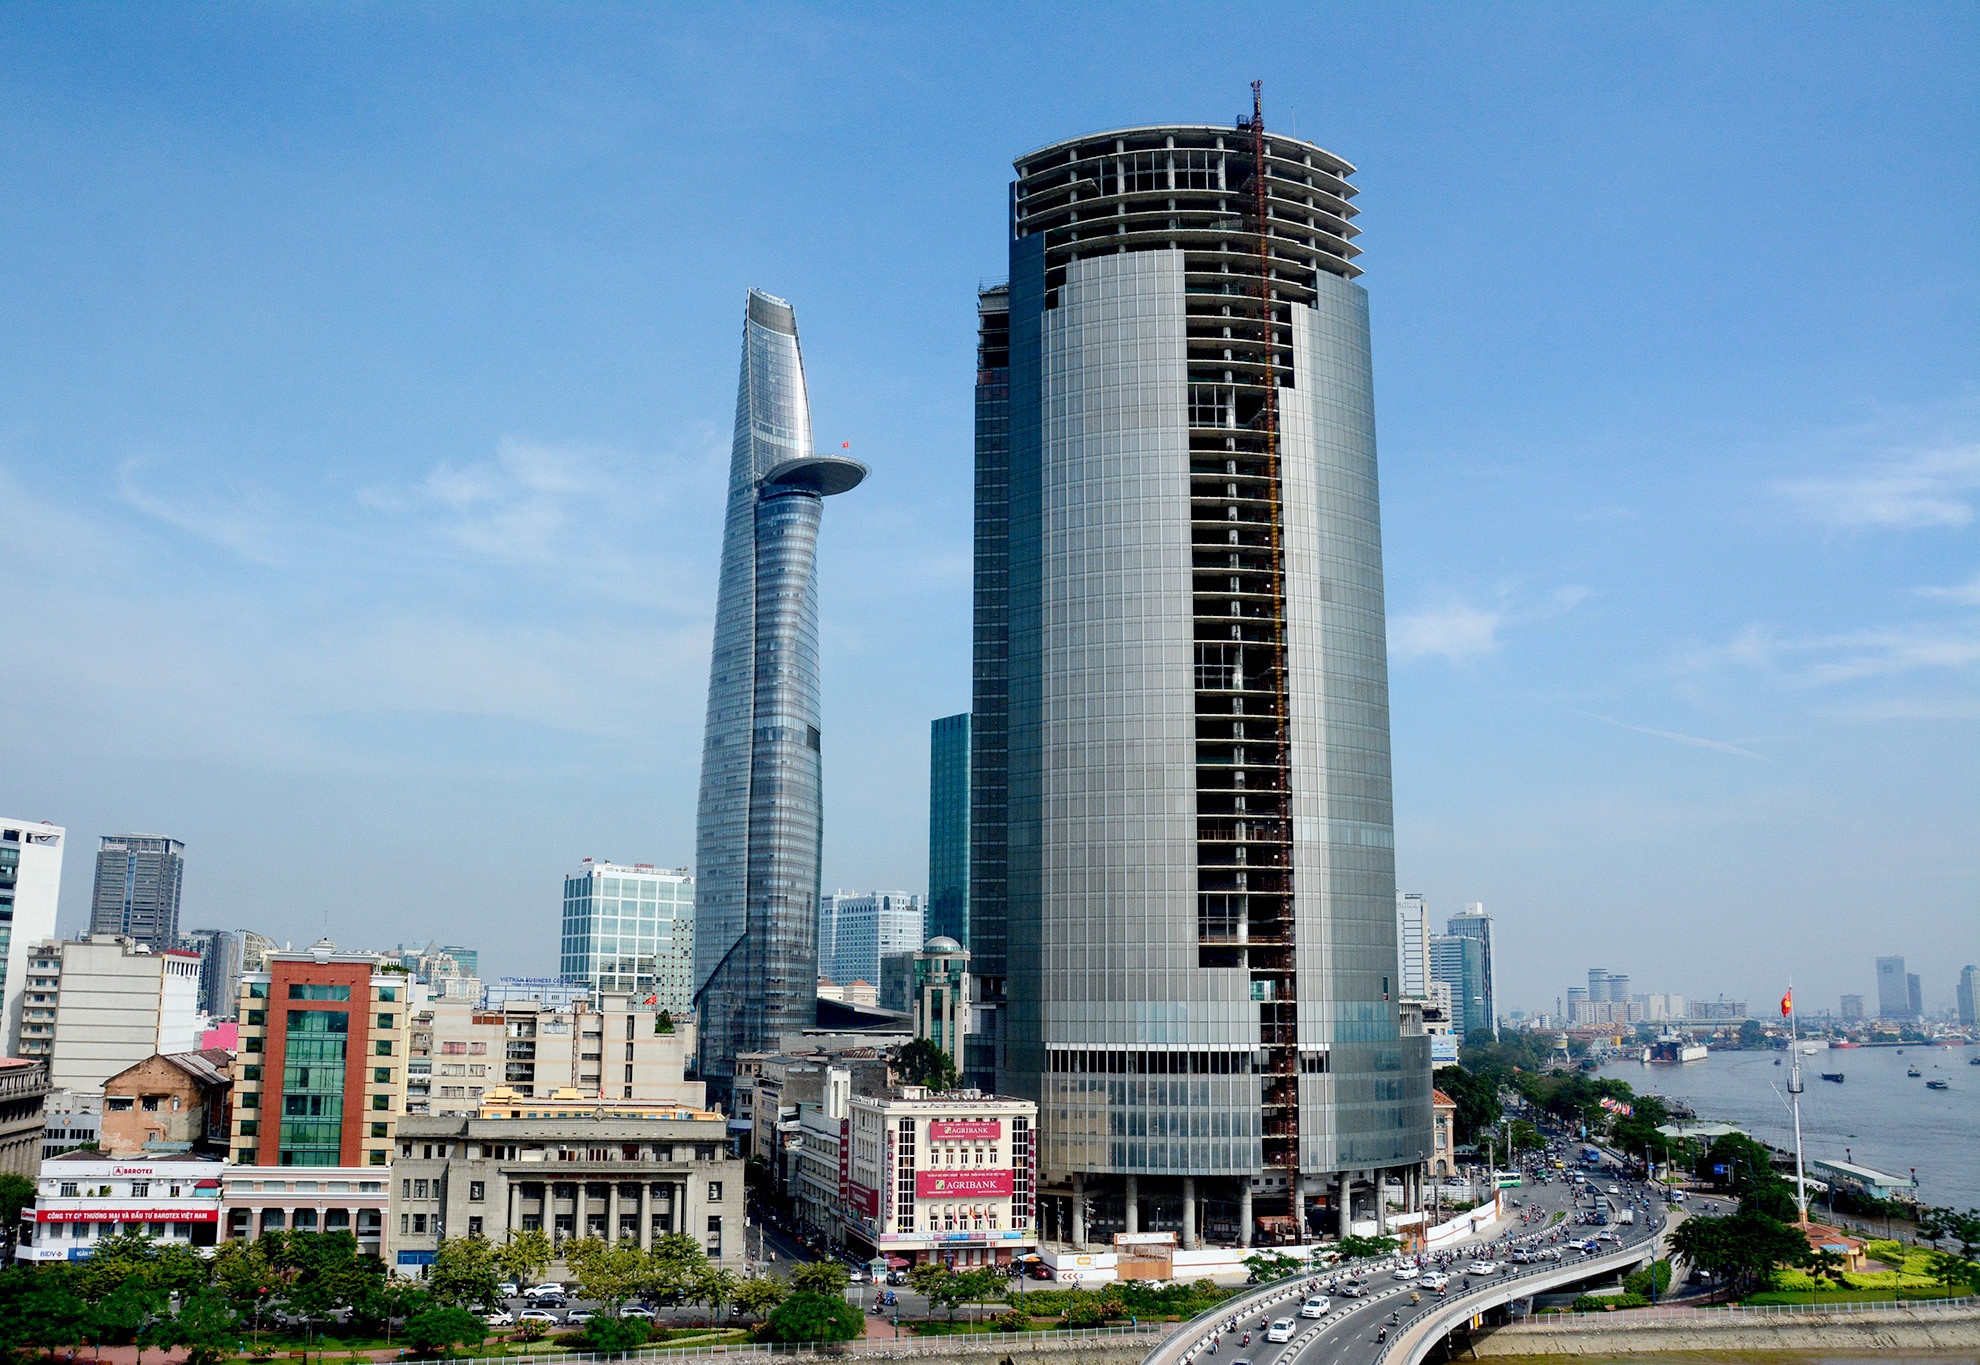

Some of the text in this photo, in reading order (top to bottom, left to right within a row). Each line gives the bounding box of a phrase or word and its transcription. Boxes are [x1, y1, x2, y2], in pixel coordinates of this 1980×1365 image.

[946, 1180, 997, 1189] AGRIBANK
[47, 1211, 64, 1219] CÔNG
[121, 1211, 130, 1219] VÀ
